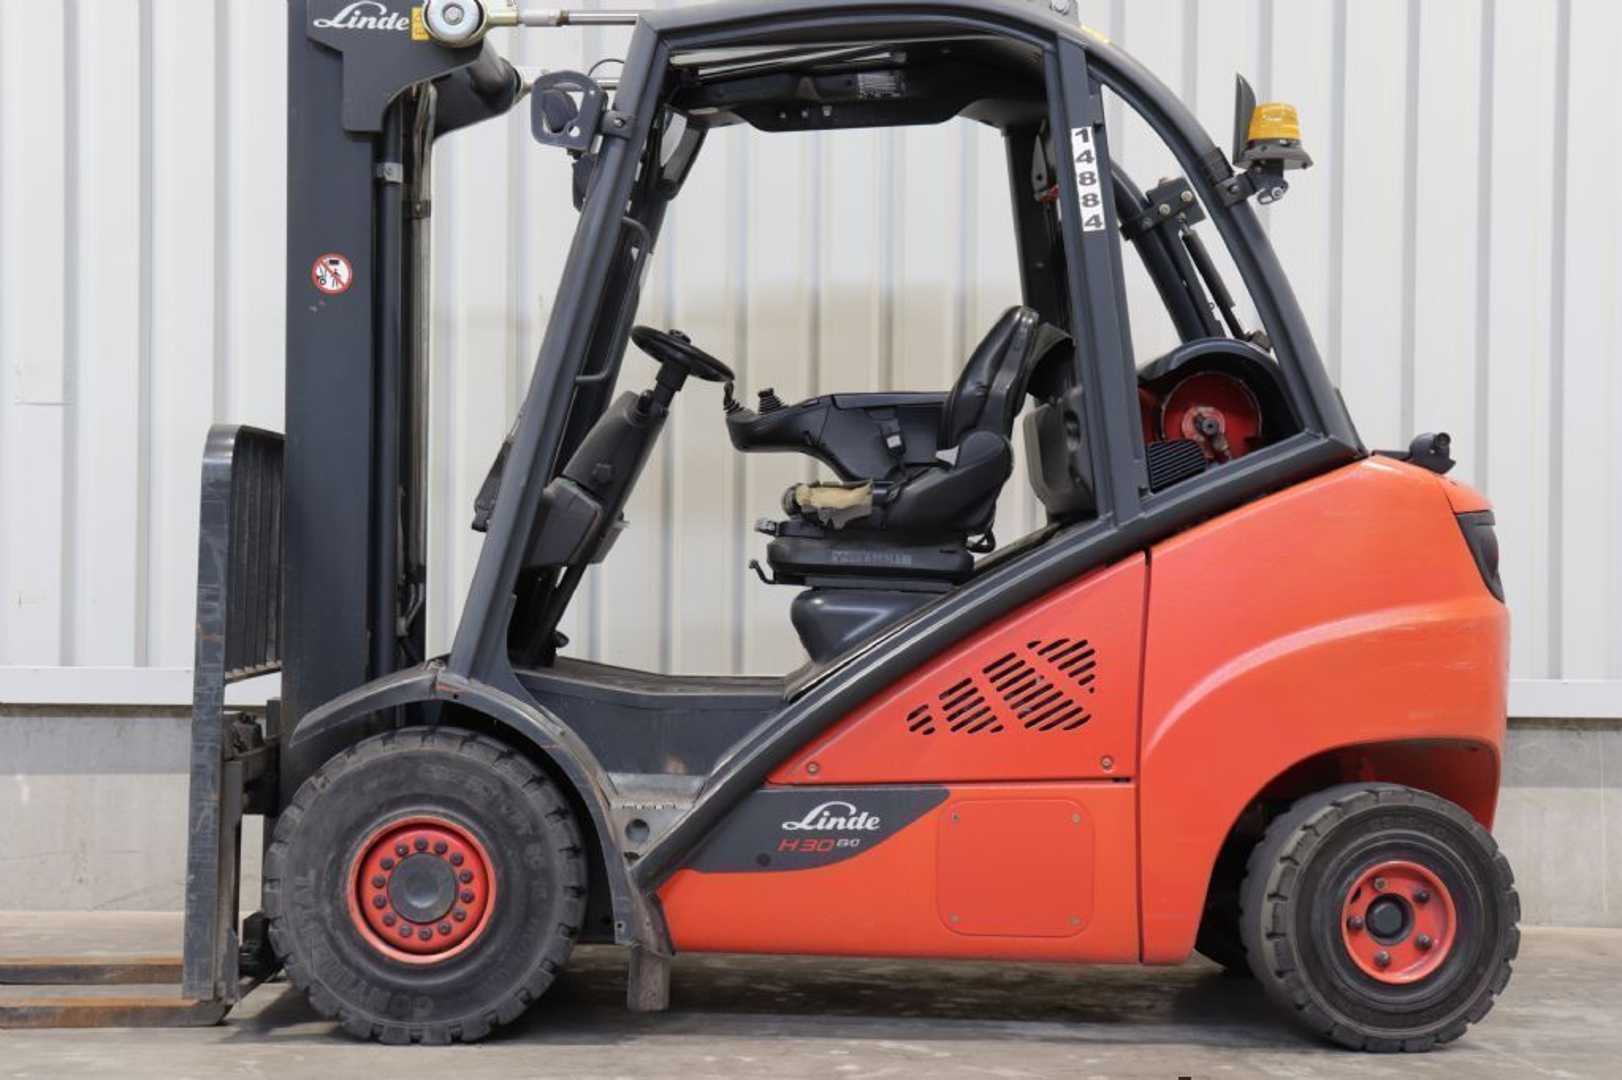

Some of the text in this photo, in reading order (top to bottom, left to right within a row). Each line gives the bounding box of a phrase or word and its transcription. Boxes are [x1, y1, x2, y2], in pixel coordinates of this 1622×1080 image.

[313, 0, 410, 31] Linde
[1074, 128, 1103, 229] 14884
[781, 801, 881, 831] Linde
[777, 838, 834, 852] H30
